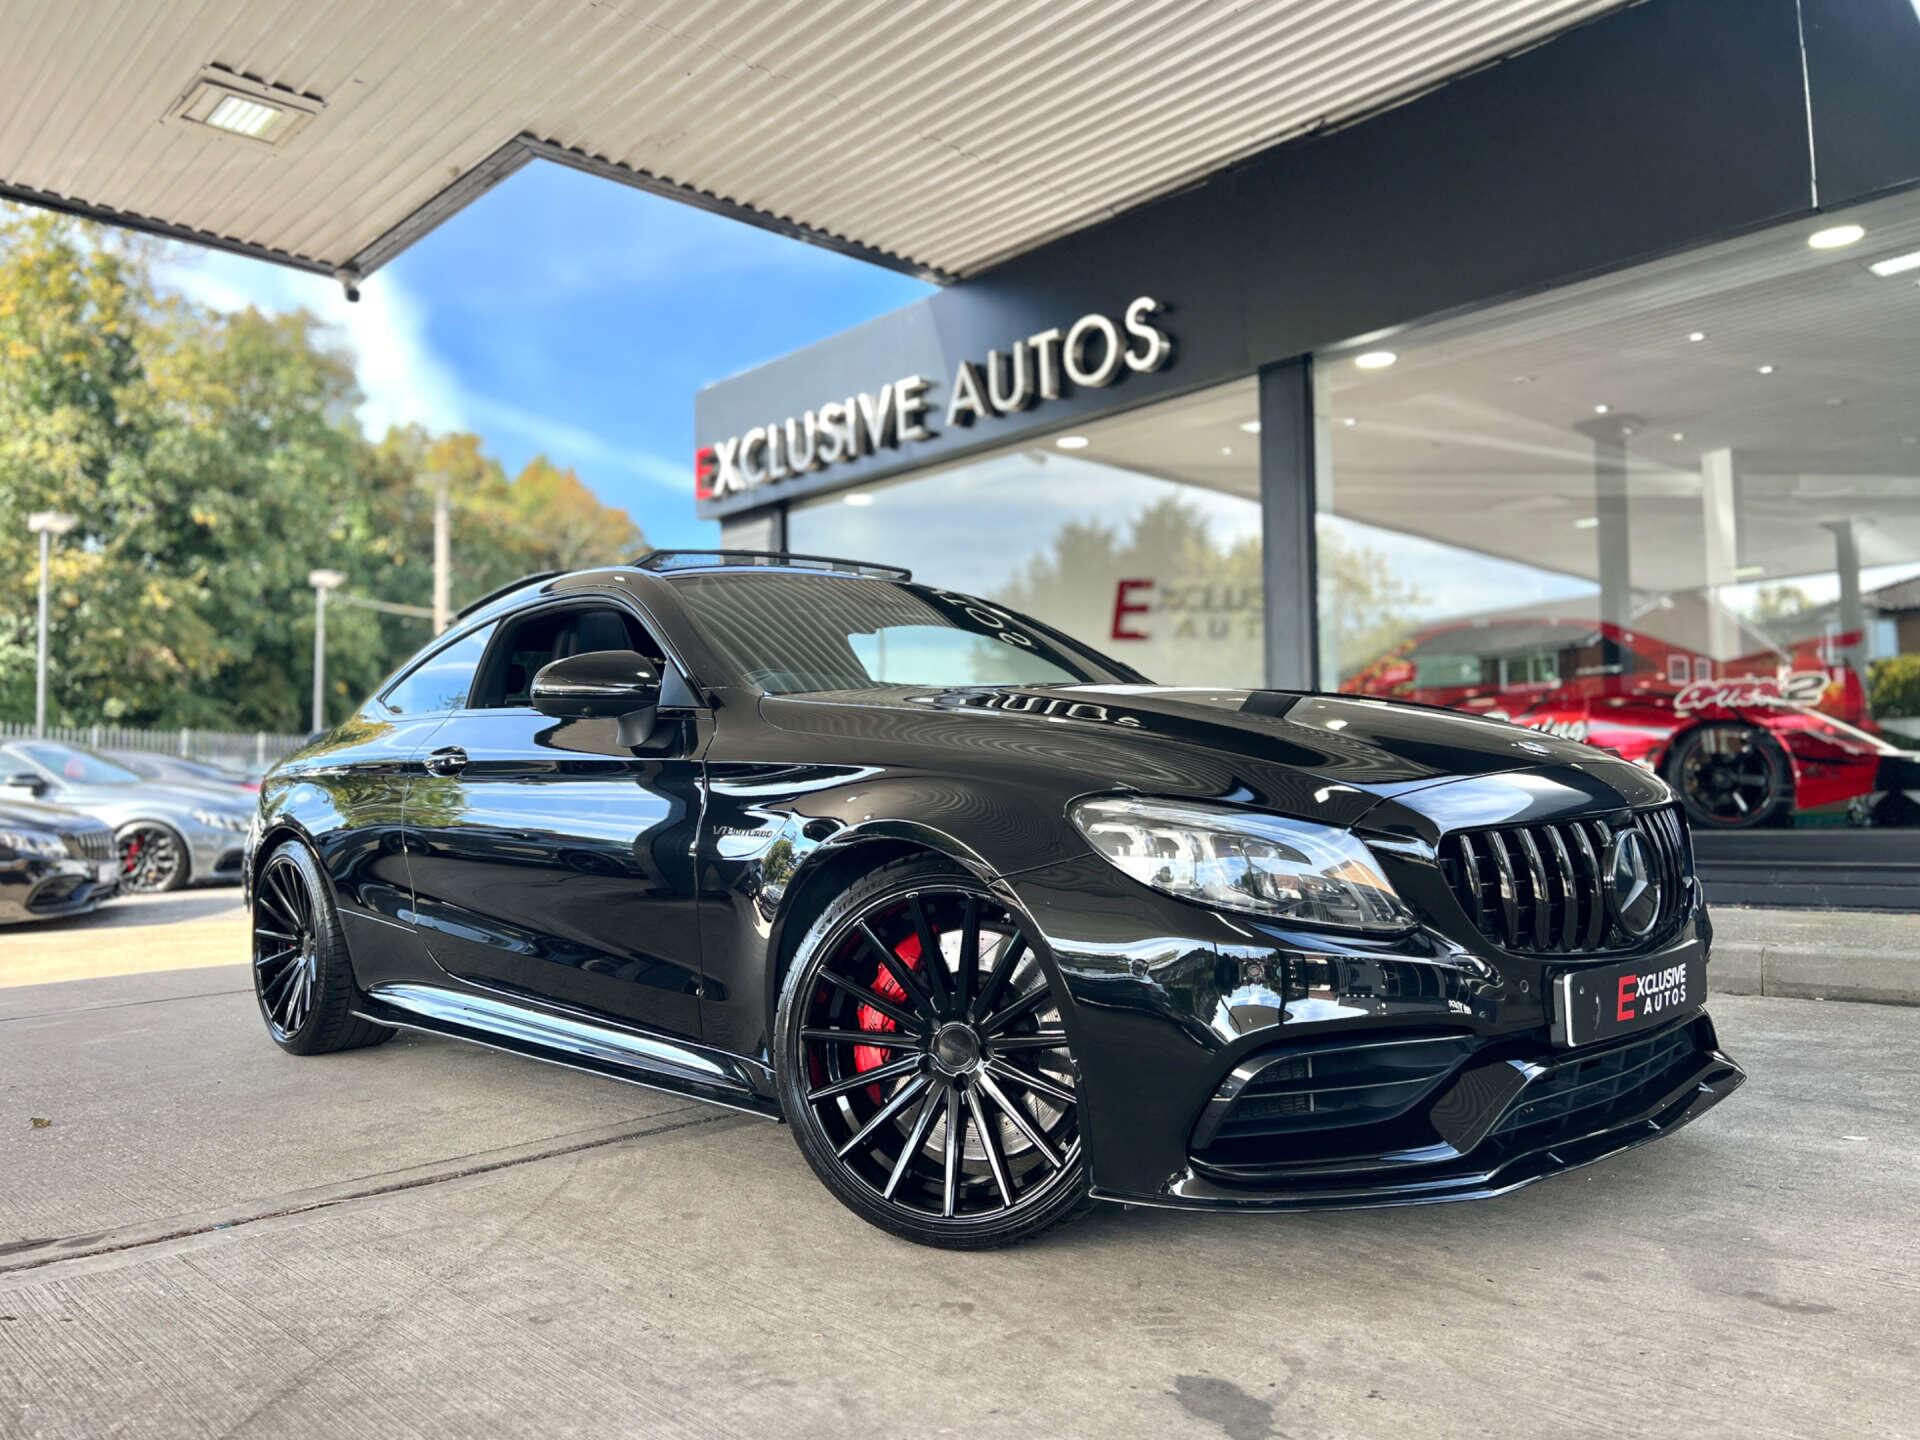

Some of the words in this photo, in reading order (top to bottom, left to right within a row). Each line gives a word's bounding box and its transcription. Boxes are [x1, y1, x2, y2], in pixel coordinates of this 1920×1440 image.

[695, 375, 928, 498] EXCLUSIVE
[945, 296, 1169, 426] AUTOS
[1617, 963, 1686, 1021] EXCLUSIVE
[1644, 985, 1686, 1014] AUTOS
